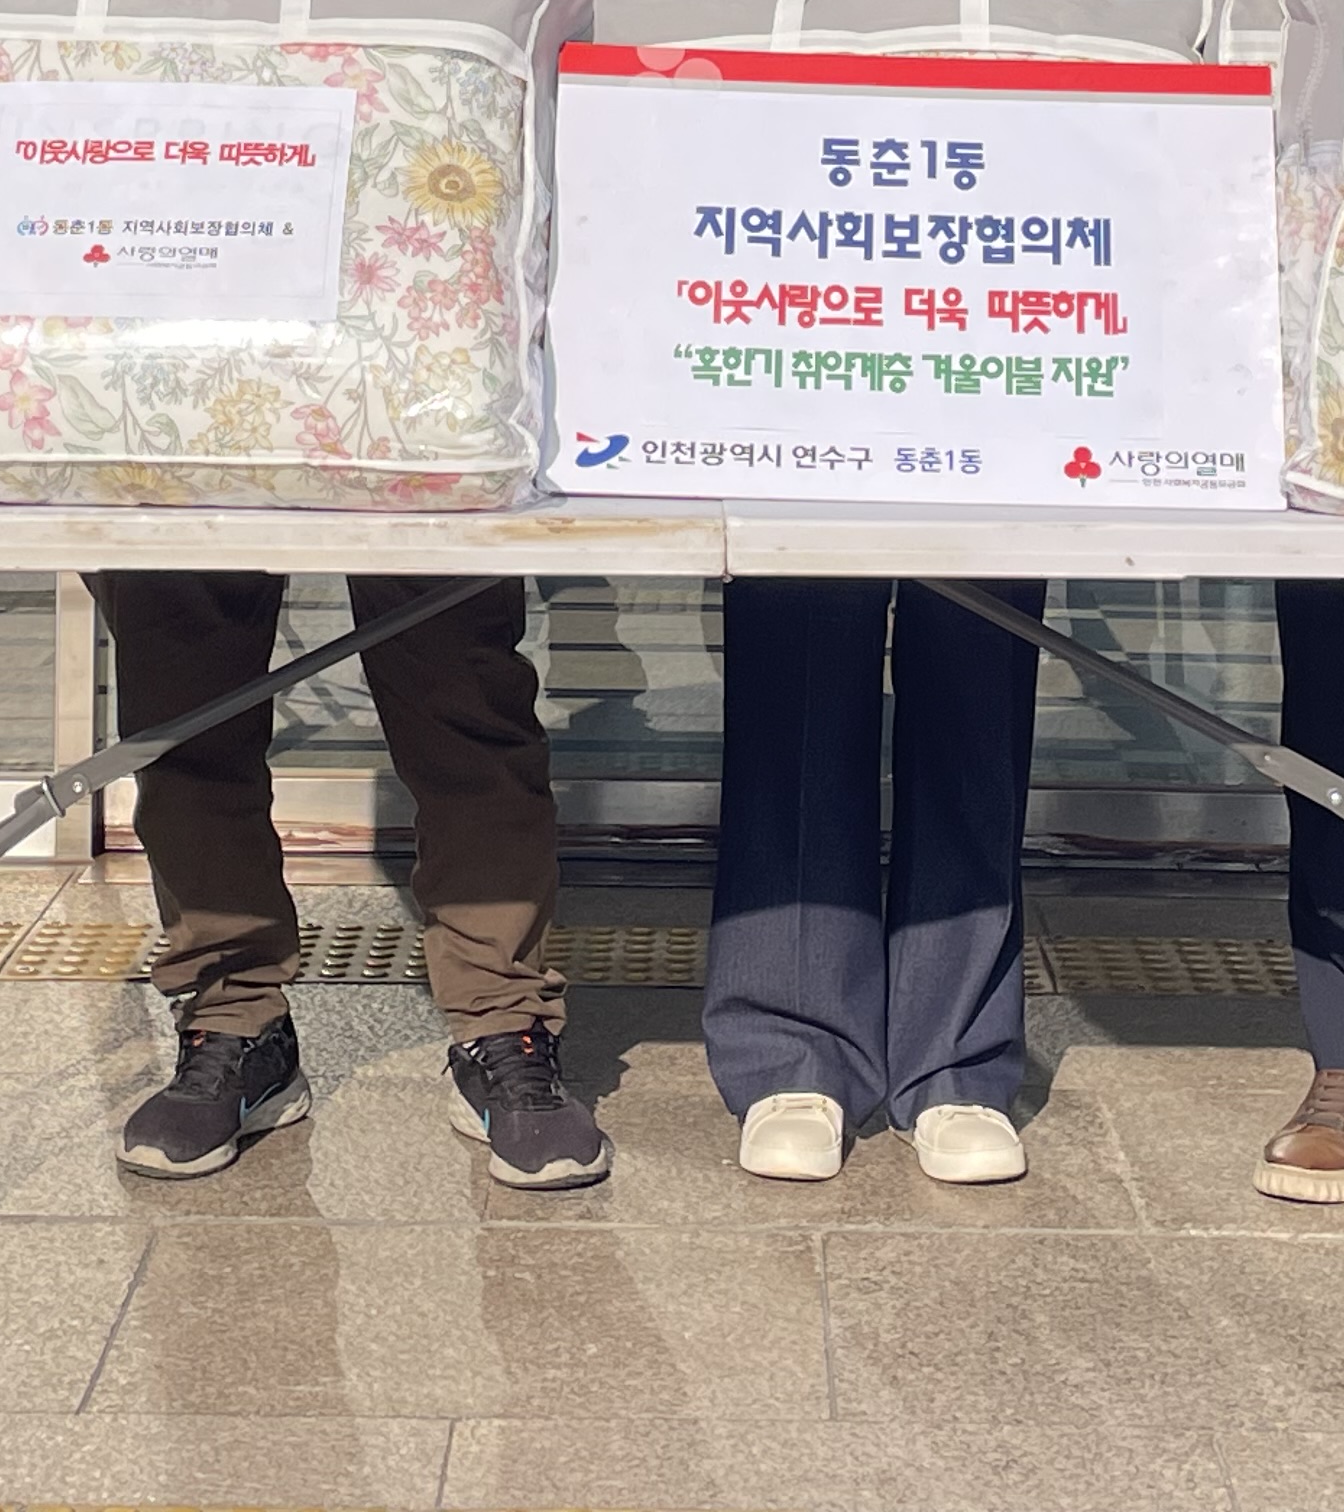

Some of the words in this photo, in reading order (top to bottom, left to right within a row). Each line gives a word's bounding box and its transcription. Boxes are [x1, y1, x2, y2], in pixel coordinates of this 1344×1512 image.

[164, 140, 210, 165] 더욱
[820, 136, 986, 191] 동춘1동
[52, 218, 113, 236] 동춘1동
[122, 219, 274, 237] 지역사회보장협의체
[282, 222, 294, 236] &
[693, 205, 1113, 267] 지역사회보장협의체
[116, 246, 219, 262] 사랑의열매
[676, 279, 885, 329] 「이웃사랑으로
[904, 286, 969, 331] 더욱
[986, 289, 1129, 335] 따뜻하게」
[790, 350, 913, 394] 취약계층
[921, 353, 1044, 396] 겨울이불
[641, 439, 783, 468] 인천광역시
[792, 444, 874, 471] 연수구
[894, 447, 983, 475] 동춘1동
[1109, 449, 1246, 477] 사랑의열매
